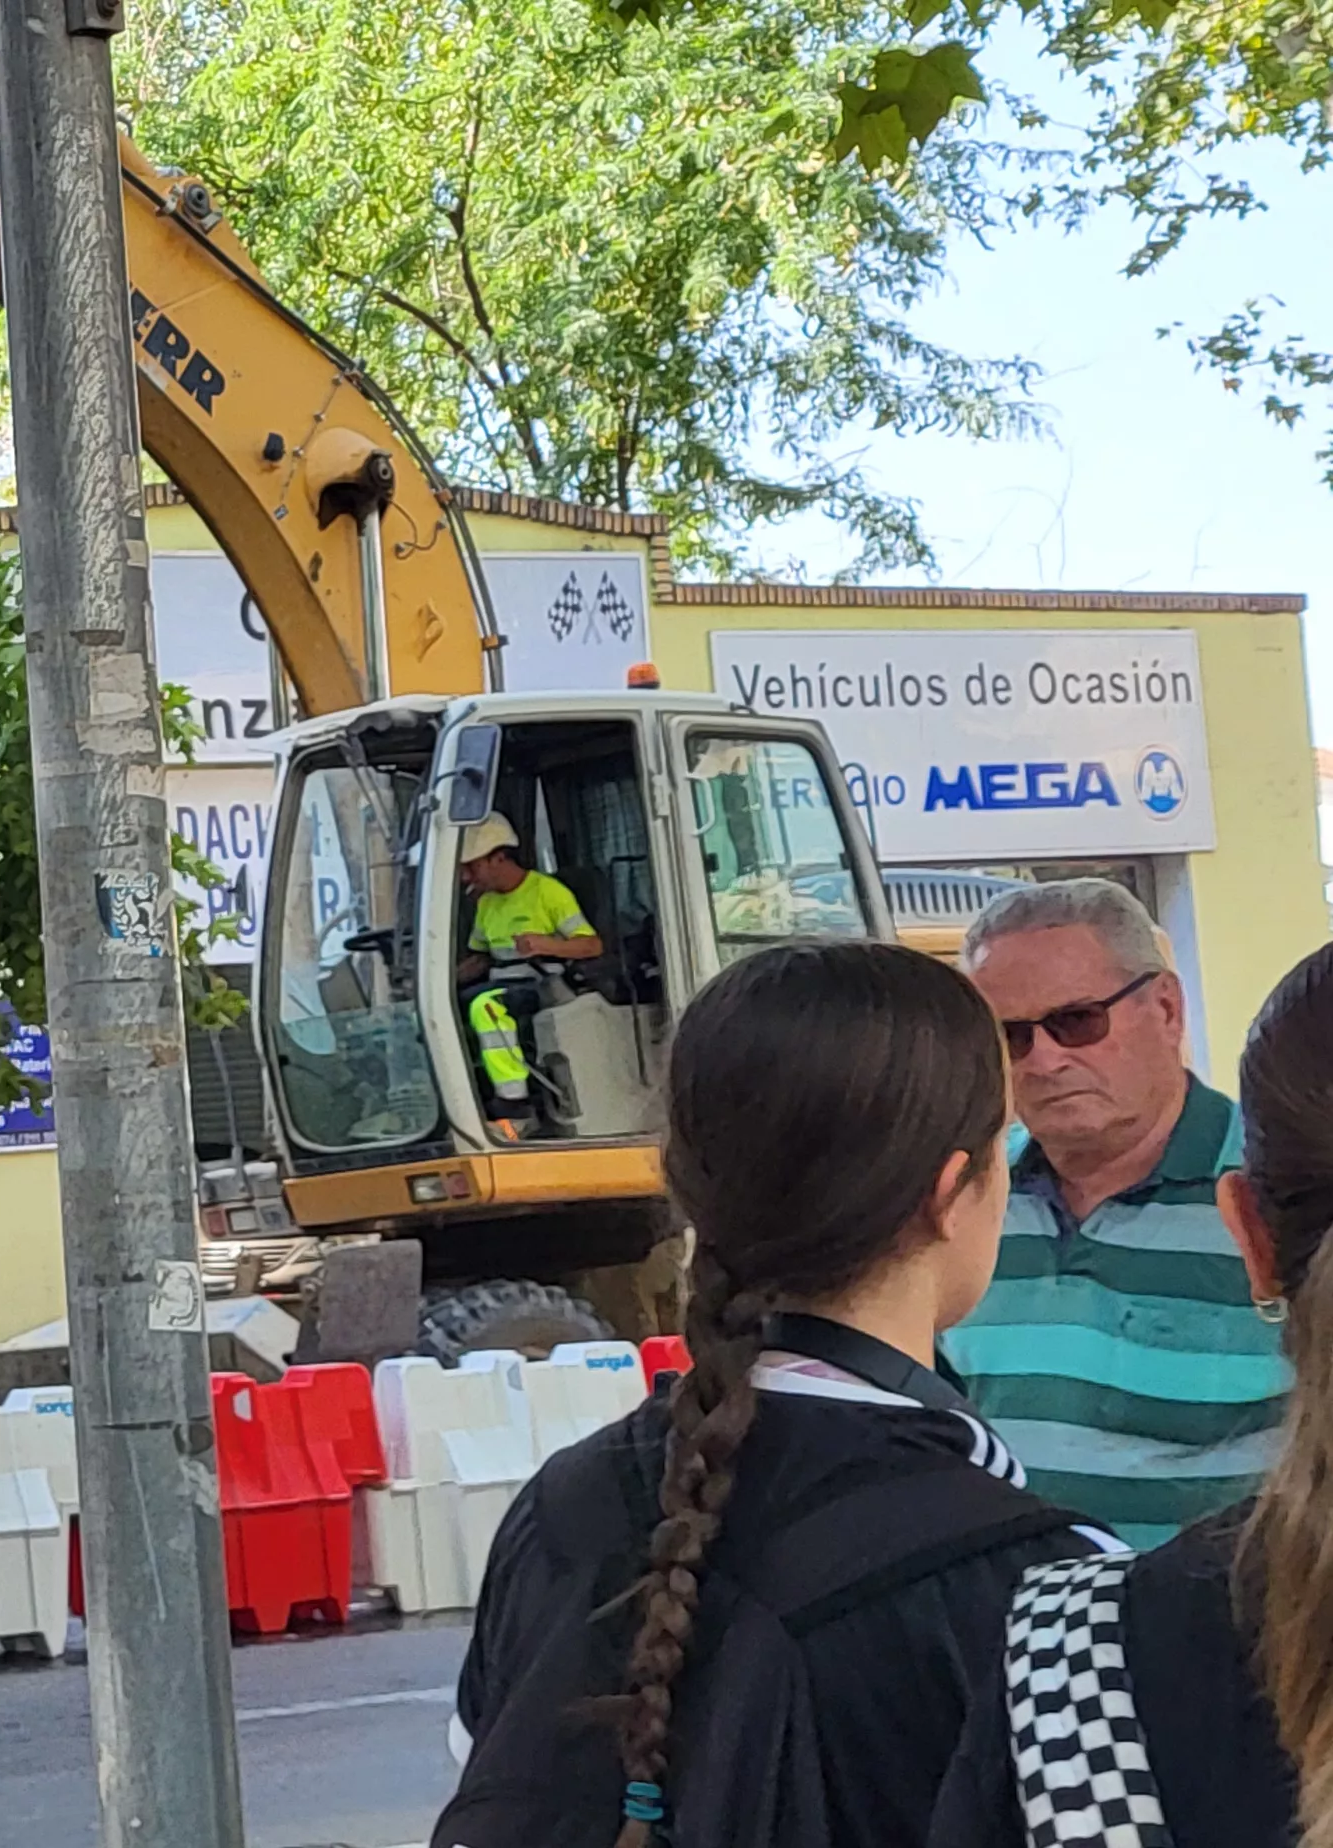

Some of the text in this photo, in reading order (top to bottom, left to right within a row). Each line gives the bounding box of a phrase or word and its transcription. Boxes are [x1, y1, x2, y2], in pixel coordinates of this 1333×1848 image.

[731, 659, 1193, 709] Vehículos de Ocasión
[923, 761, 1122, 812] MEGA
